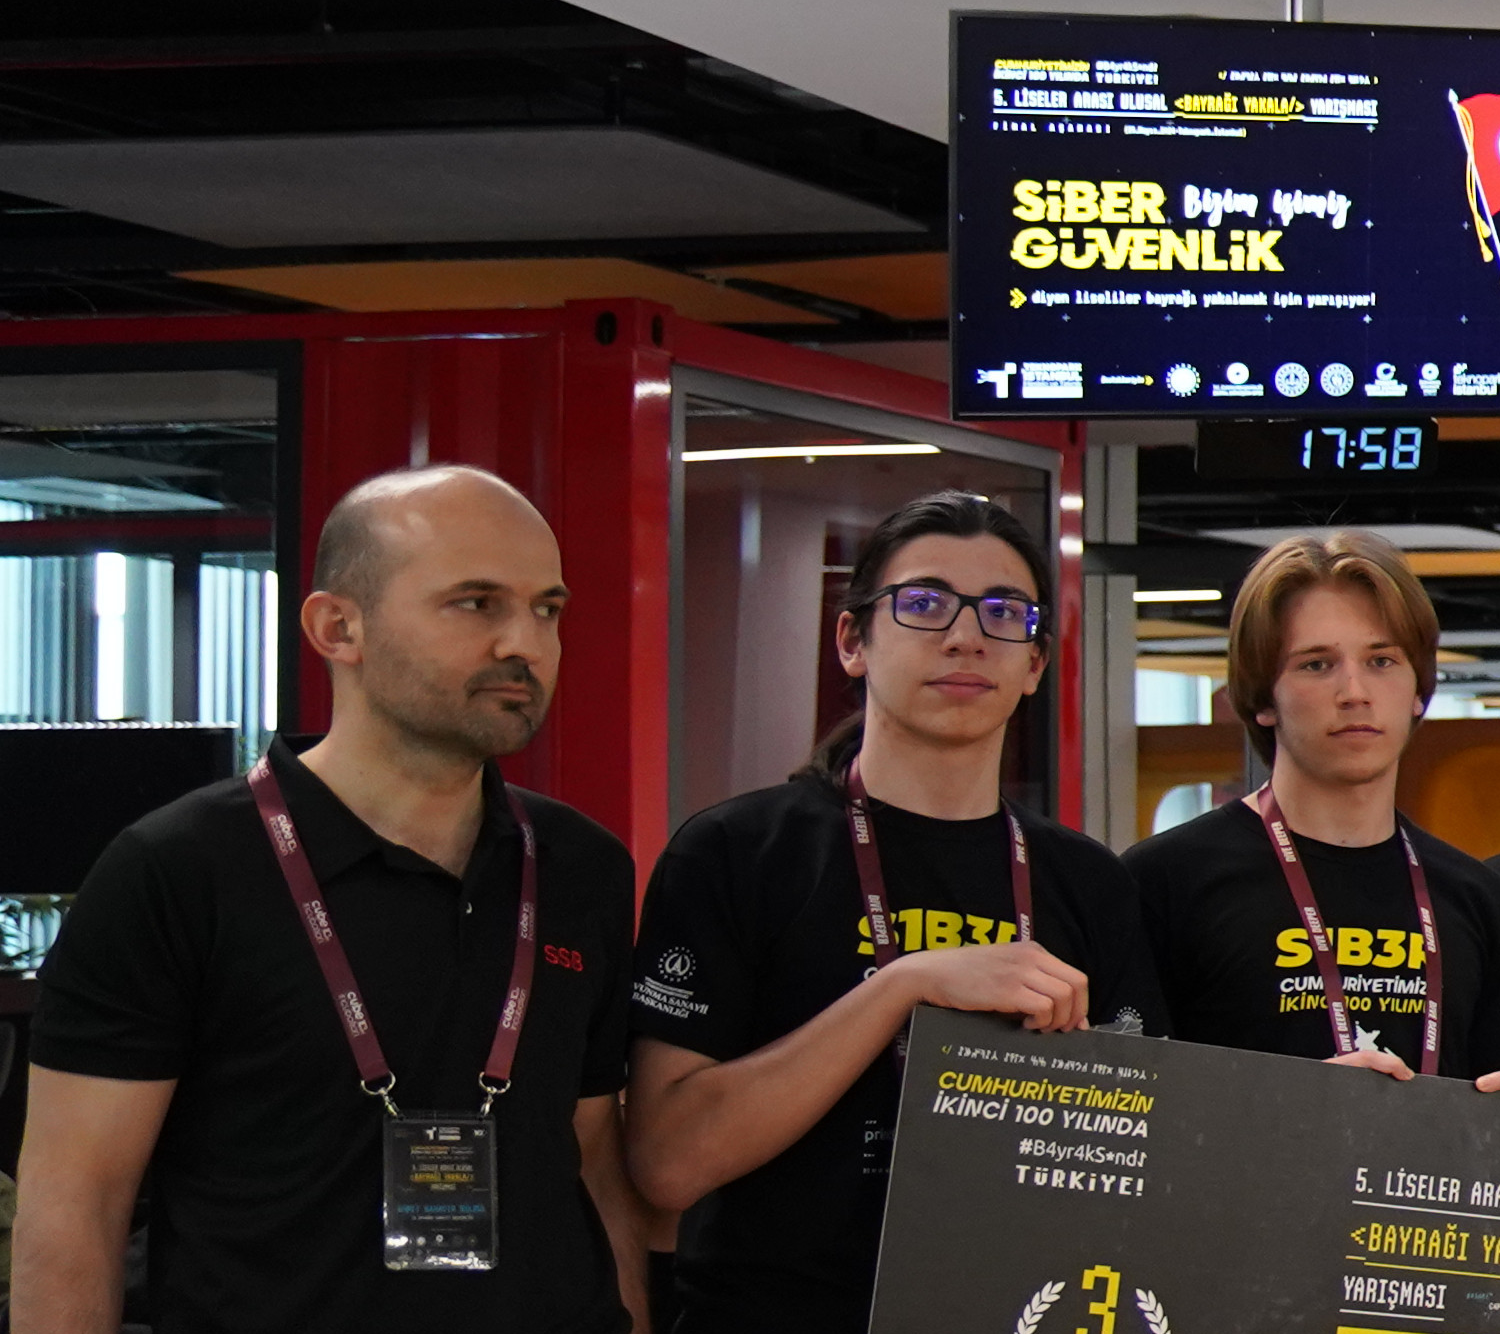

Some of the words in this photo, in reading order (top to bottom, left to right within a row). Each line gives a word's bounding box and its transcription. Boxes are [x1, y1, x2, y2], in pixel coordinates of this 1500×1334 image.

[993, 89, 1008, 107] 5.
[1014, 87, 1067, 109] LİSELER
[1073, 92, 1114, 109] ARASI
[1120, 93, 1167, 110] ULUSAL
[1183, 183, 1258, 227] Bizim
[1032, 290, 1070, 307] diyen
[1146, 289, 1197, 307] bayrağı
[1302, 426, 1422, 471] 17:58
[868, 895, 883, 916] DIVE
[872, 915, 889, 945] DEEPER
[1275, 927, 1428, 969] SB3
[544, 944, 584, 972] SSB
[939, 1071, 1154, 1114] CUMHURİYETİMİZİN
[933, 1090, 1010, 1121] İKİNCİ
[1015, 1104, 1054, 1126] 100
[1063, 1110, 1148, 1138] YILINDA
[1354, 1167, 1374, 1194] 5.
[1385, 1167, 1461, 1204] LİSELER
[1350, 1222, 1470, 1262] <BAYRAĞI
[1344, 1275, 1448, 1310] YARIŞMASI
